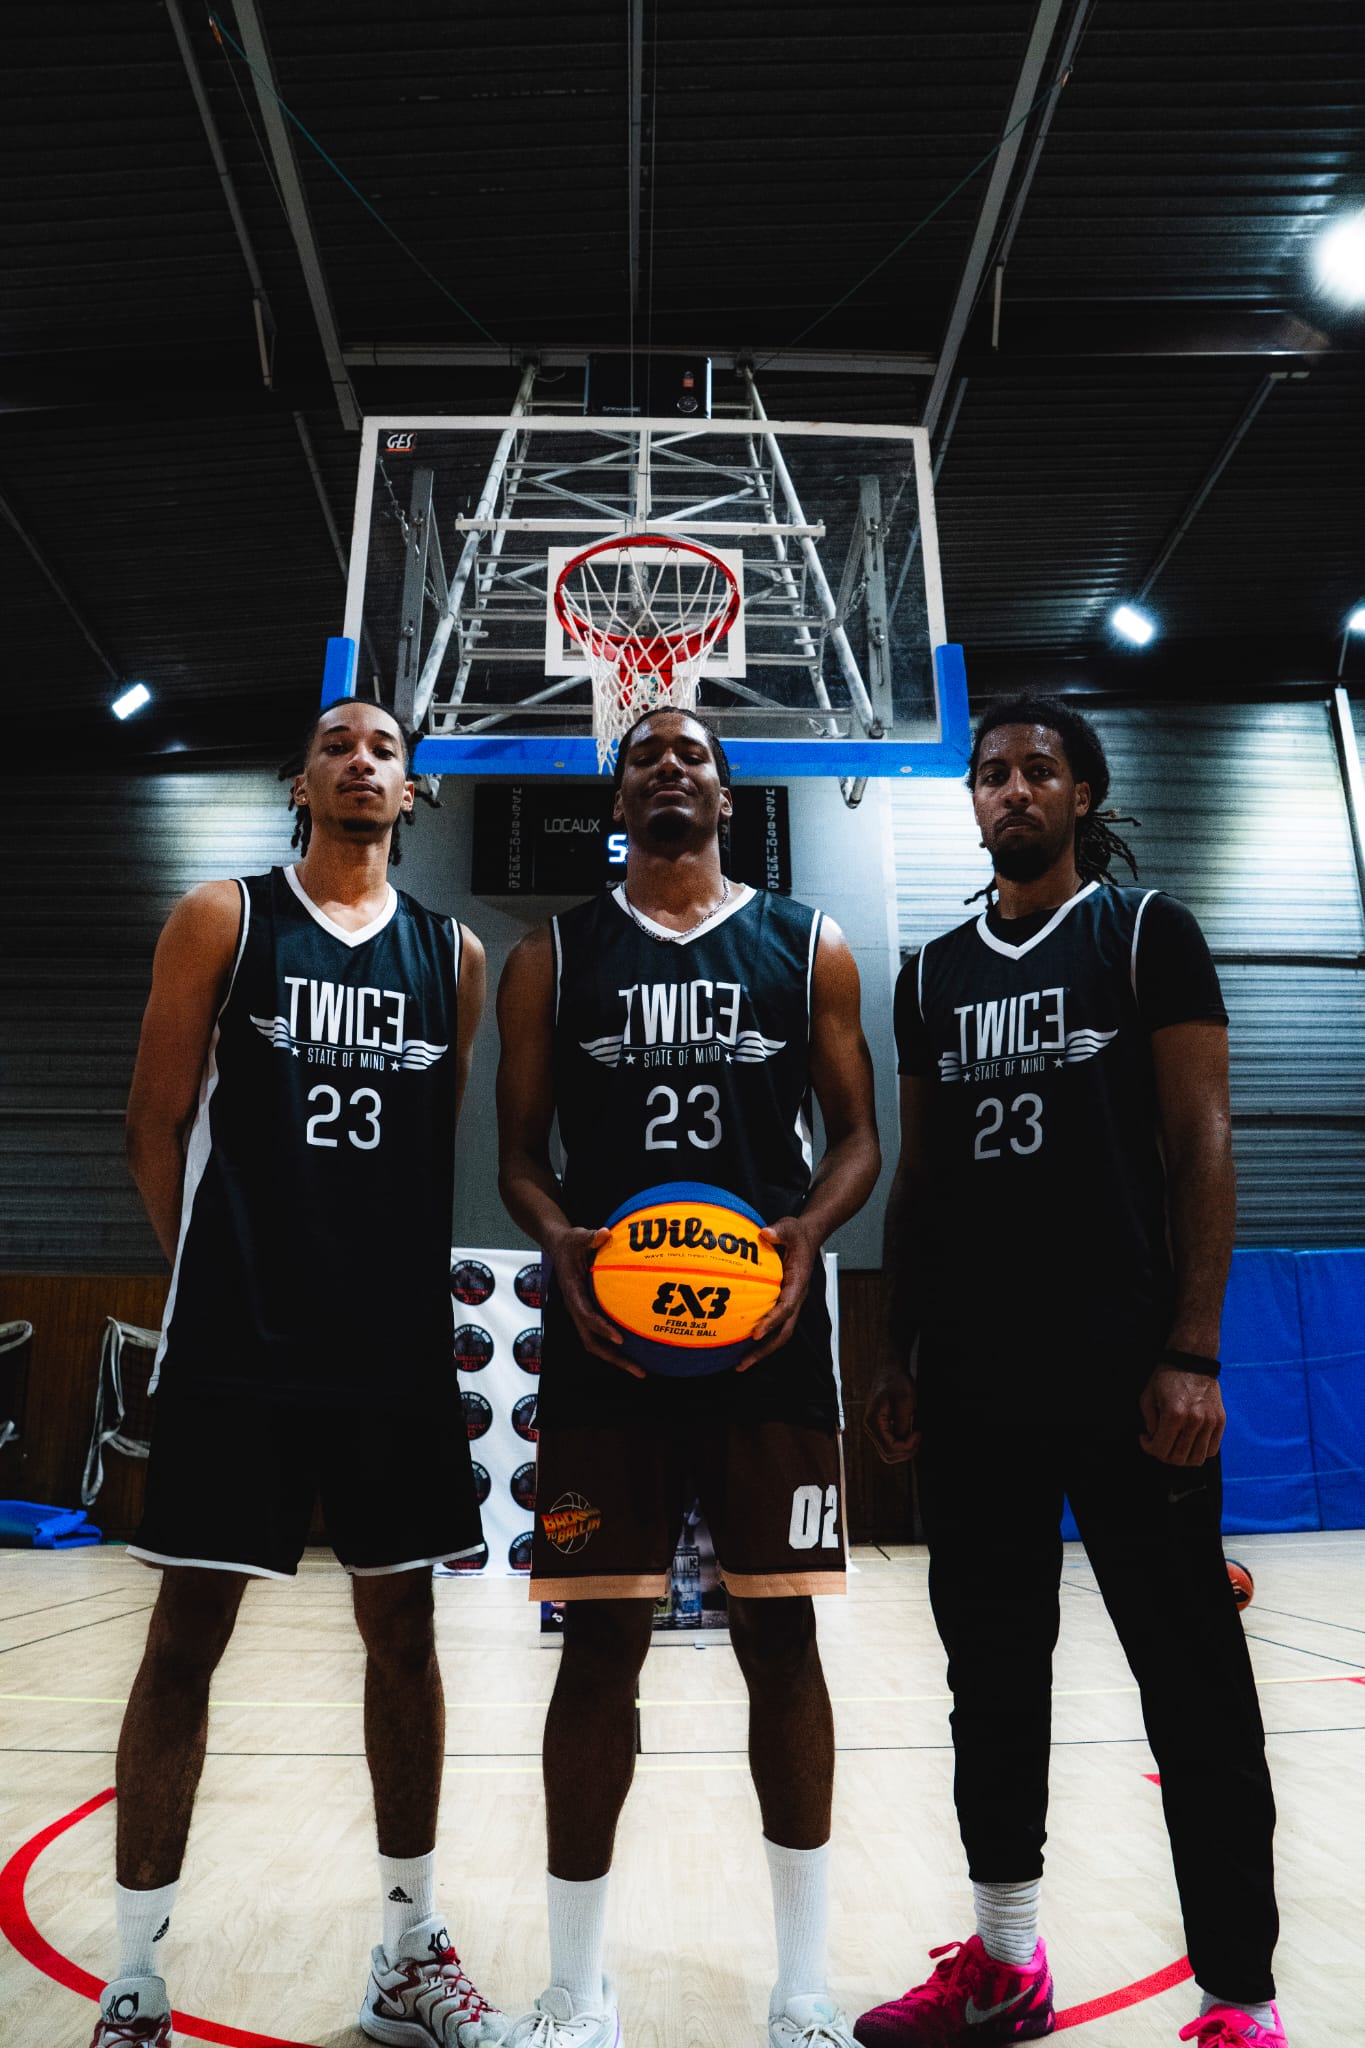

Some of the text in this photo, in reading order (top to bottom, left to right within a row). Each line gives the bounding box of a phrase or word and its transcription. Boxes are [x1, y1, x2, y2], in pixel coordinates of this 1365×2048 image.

[387, 433, 415, 449] GES
[544, 818, 601, 833] LOCAUX
[308, 1047, 385, 1071] STATE OF MIND
[644, 1045, 720, 1068] STATE OF MIND
[974, 1056, 1045, 1082] STATE OF MIND
[306, 1084, 382, 1150] 23
[645, 1084, 722, 1150] 23
[974, 1092, 1043, 1160] 23
[628, 1217, 760, 1265] Wilson
[653, 1324, 717, 1337] OFFICIAL BALL
[666, 1319, 688, 1327] FIBA
[788, 1484, 839, 1550] 02
